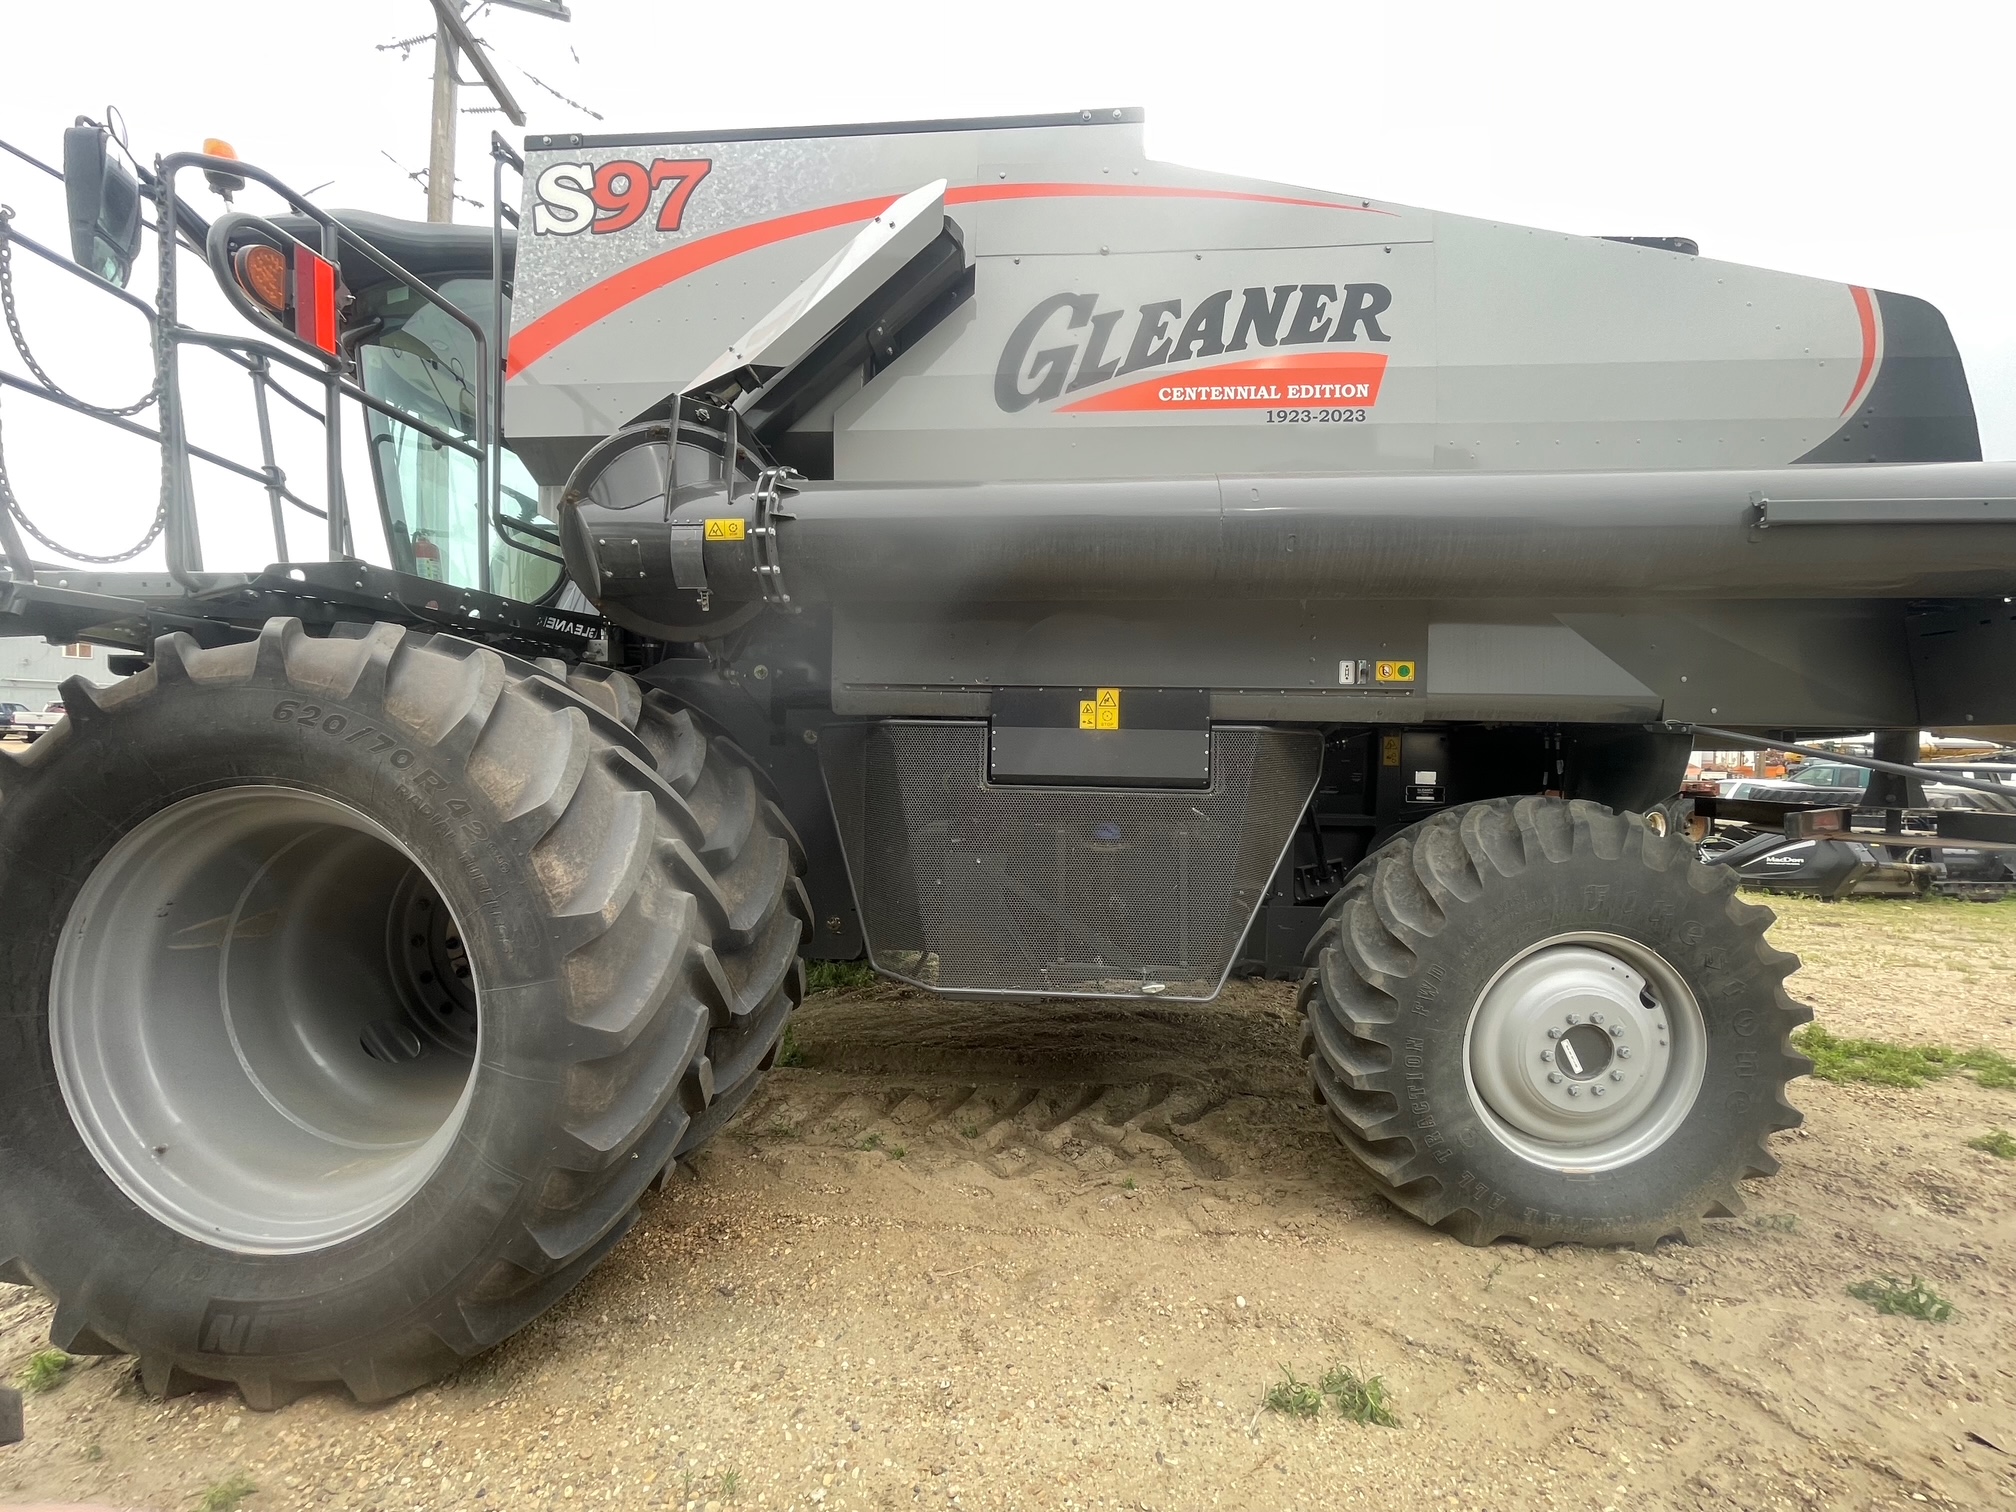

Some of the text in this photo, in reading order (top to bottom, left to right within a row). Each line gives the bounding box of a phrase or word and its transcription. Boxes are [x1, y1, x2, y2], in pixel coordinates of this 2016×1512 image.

[532, 158, 712, 236] S97
[994, 283, 1393, 414] GLEANER
[1158, 384, 1370, 402] CENTENNIAL EDITION
[1266, 409, 1367, 424] 1923-2023
[271, 700, 491, 846] 620/70 R 42
[393, 783, 456, 841] RADIAL
[1766, 856, 1805, 864] MacDon
[1404, 1036, 1454, 1165] TRACTION
[1458, 1170, 1506, 1211] ALL
